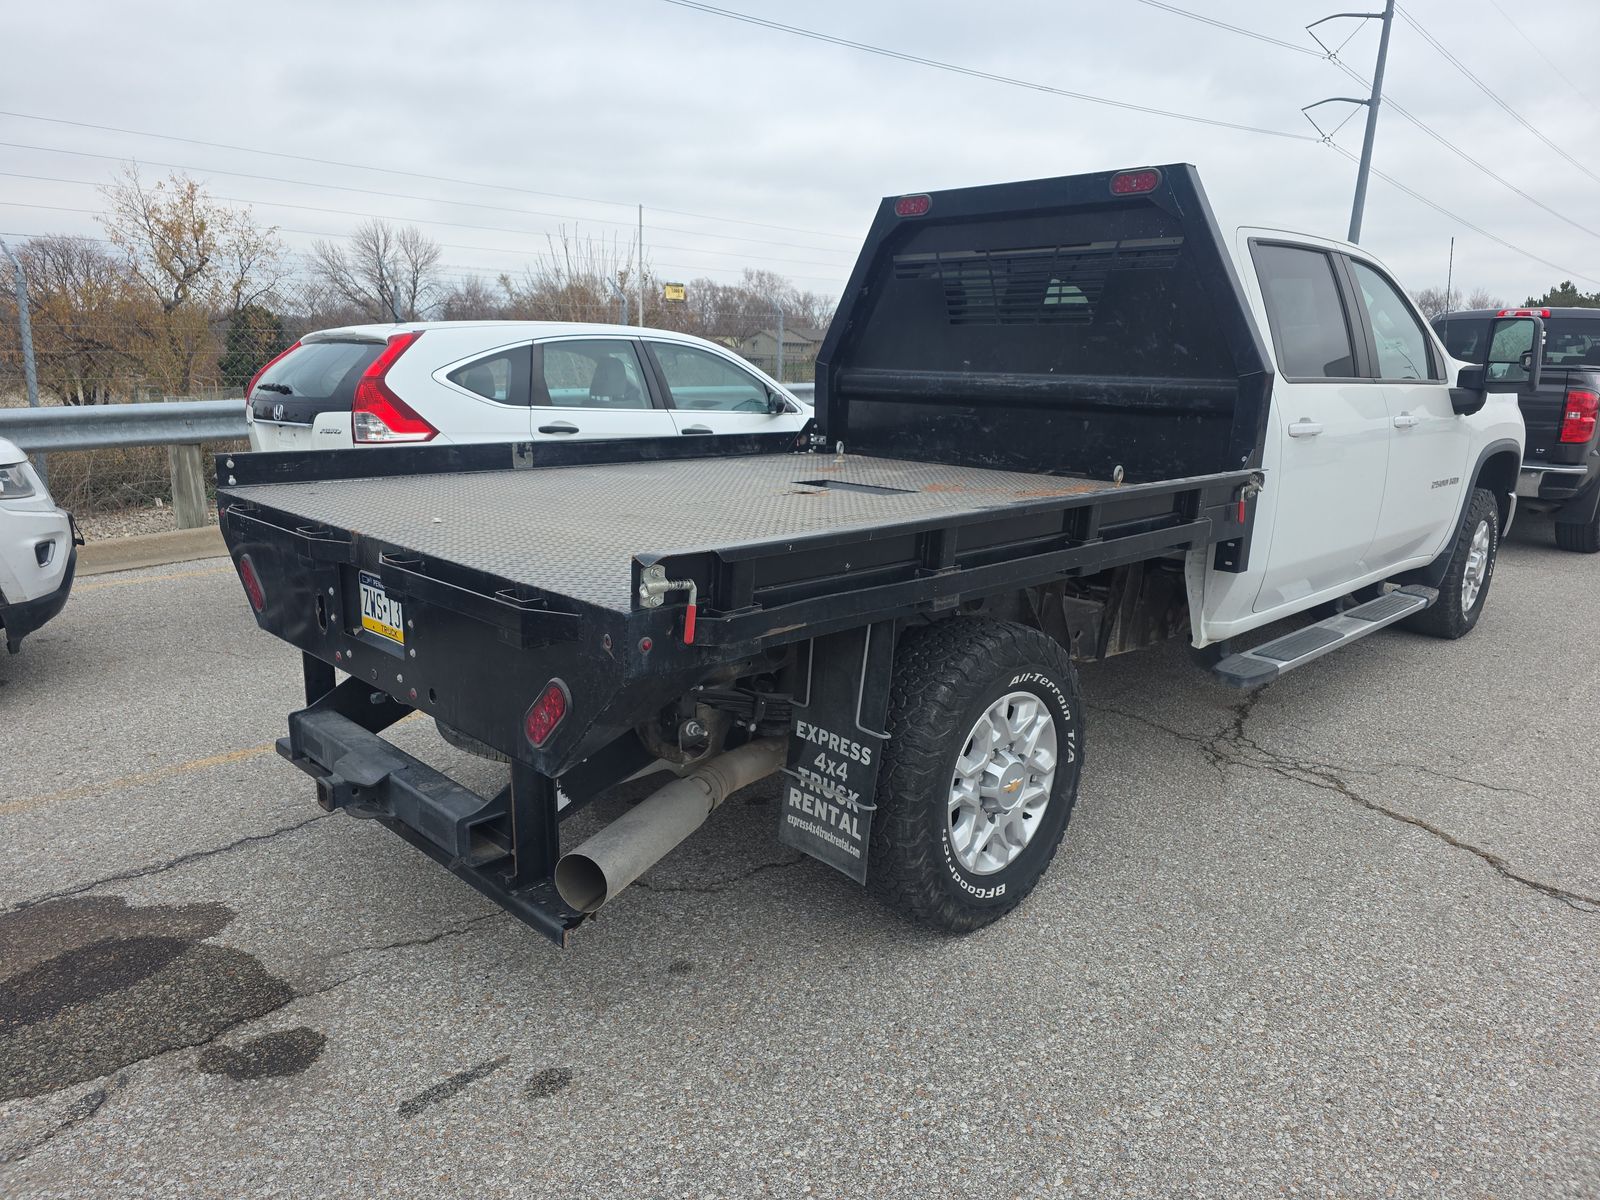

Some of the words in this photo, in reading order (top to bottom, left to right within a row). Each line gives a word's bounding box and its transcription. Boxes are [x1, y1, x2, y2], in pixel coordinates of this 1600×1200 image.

[381, 624, 399, 639] TRUCK
[1008, 672, 1071, 721] All-Terrain
[1067, 729, 1075, 763] T/A
[796, 720, 872, 766] EXPRESS
[798, 766, 859, 814] TRUCK
[814, 752, 848, 782] 4x4
[787, 814, 861, 859] express4x4truckrental.com
[789, 787, 862, 841] RENTAL
[941, 828, 1006, 899] BFGoodrich
